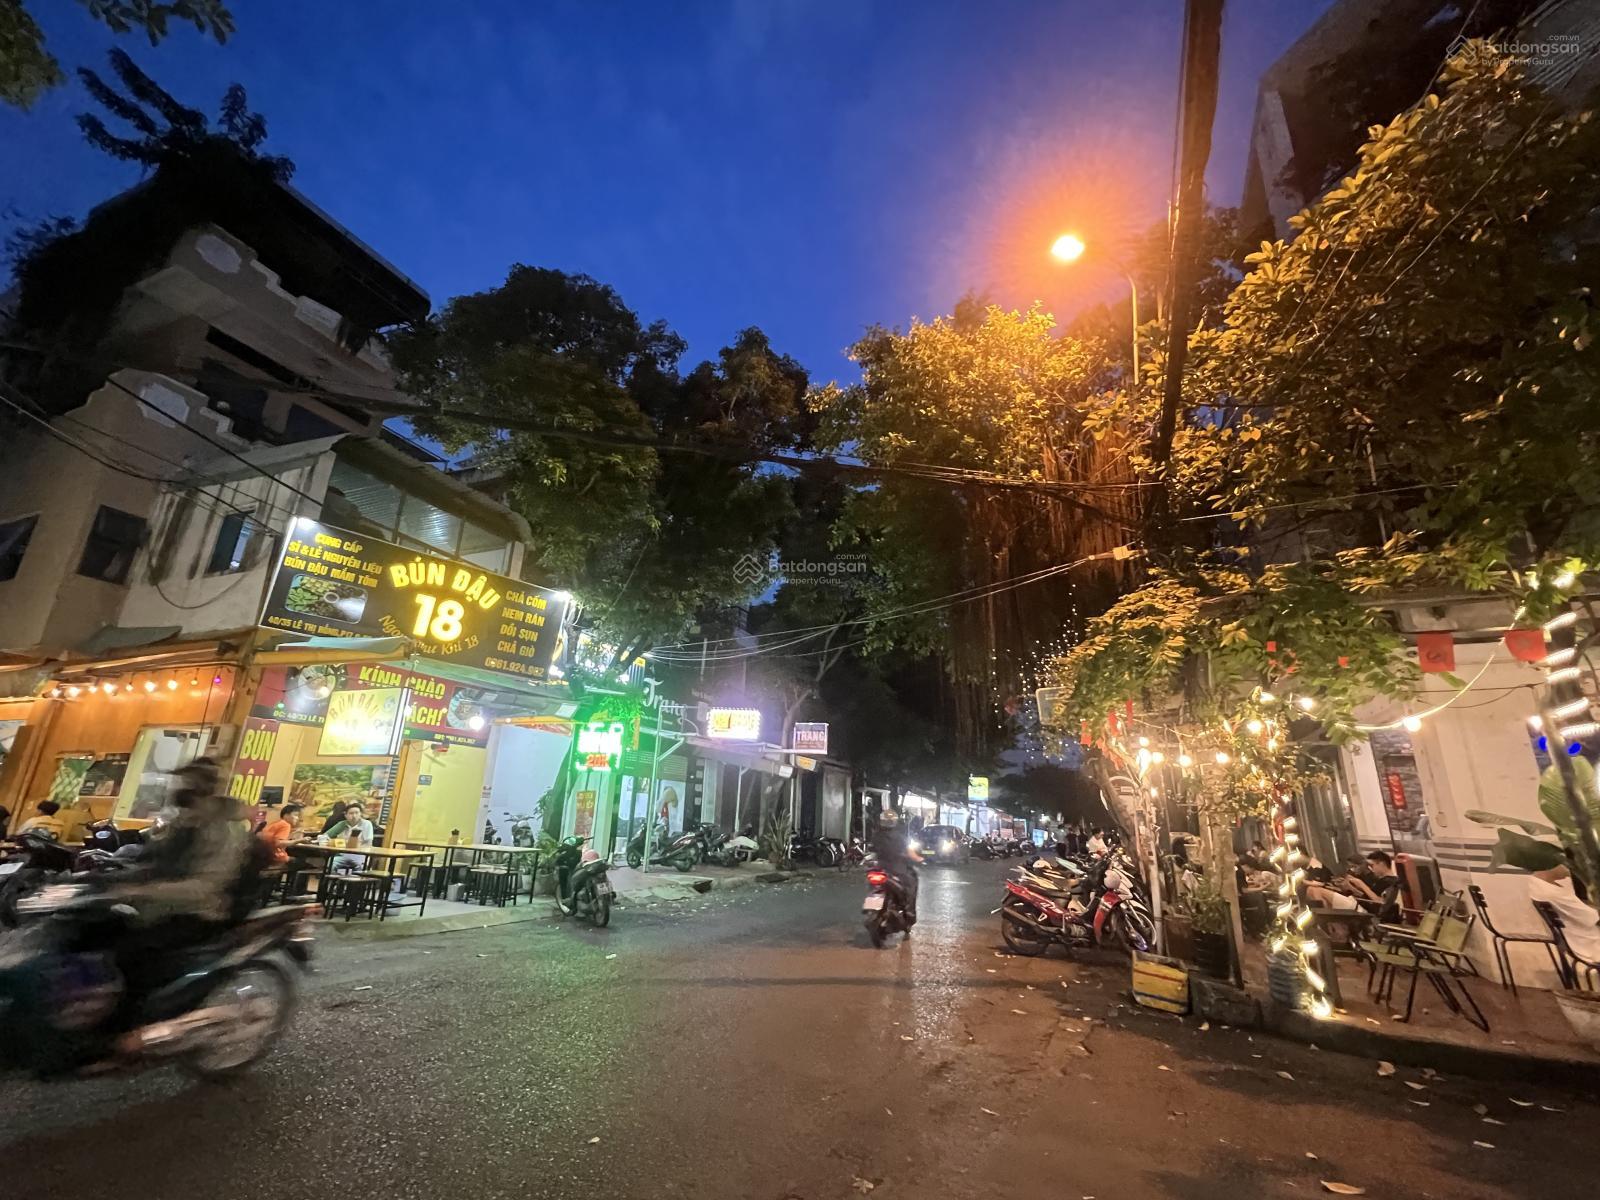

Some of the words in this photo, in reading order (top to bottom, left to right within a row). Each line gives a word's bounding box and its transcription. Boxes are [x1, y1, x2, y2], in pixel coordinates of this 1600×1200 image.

[283, 555, 307, 570] BÚN
[307, 562, 329, 576] ĐẬU
[322, 551, 361, 569] NGUYÊN
[389, 556, 446, 588] BÚN
[451, 569, 501, 609] ĐẬU
[412, 593, 465, 641] 18
[502, 607, 523, 621] NEM
[525, 611, 545, 627] RÁN
[358, 665, 402, 688] KÍNH
[239, 723, 277, 762] BÚN
[797, 730, 825, 746] TRANG
